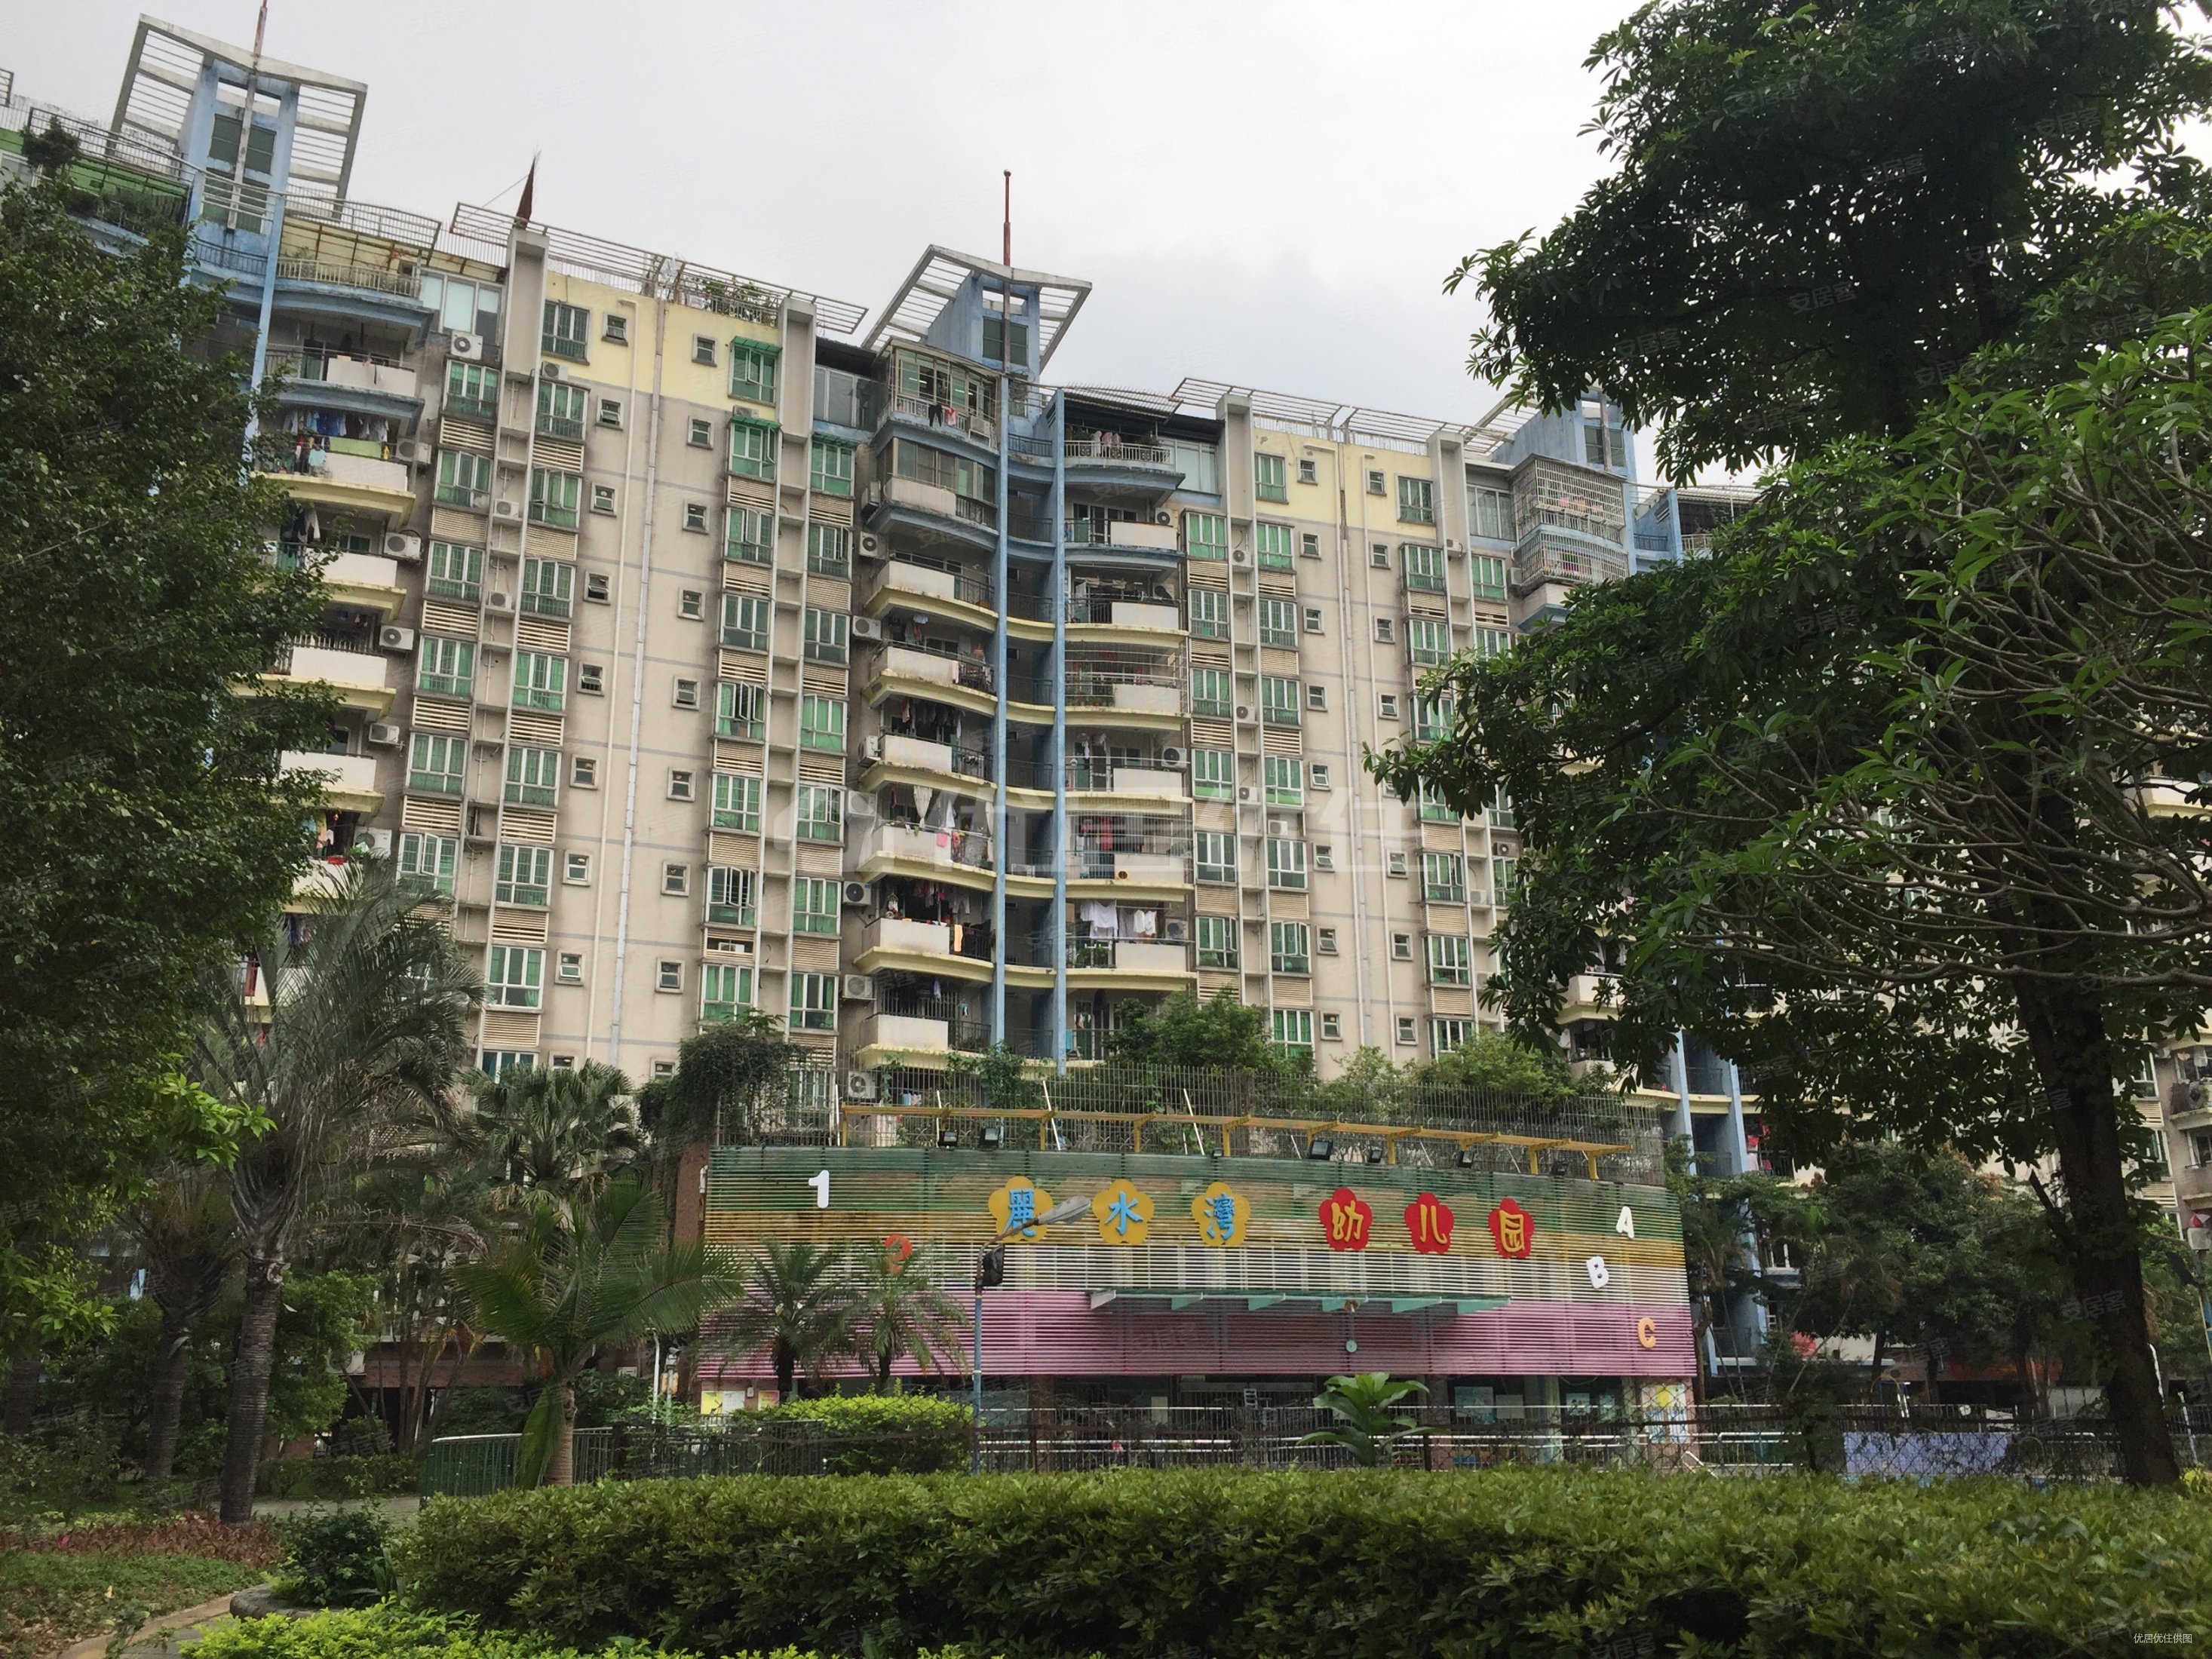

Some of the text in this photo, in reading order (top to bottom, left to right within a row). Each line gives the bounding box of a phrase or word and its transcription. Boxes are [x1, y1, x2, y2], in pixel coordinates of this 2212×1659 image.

[808, 1170, 830, 1209] 1
[1615, 1206, 1635, 1239] A
[1586, 1256, 1609, 1289] B
[1637, 1317, 1656, 1348] C
